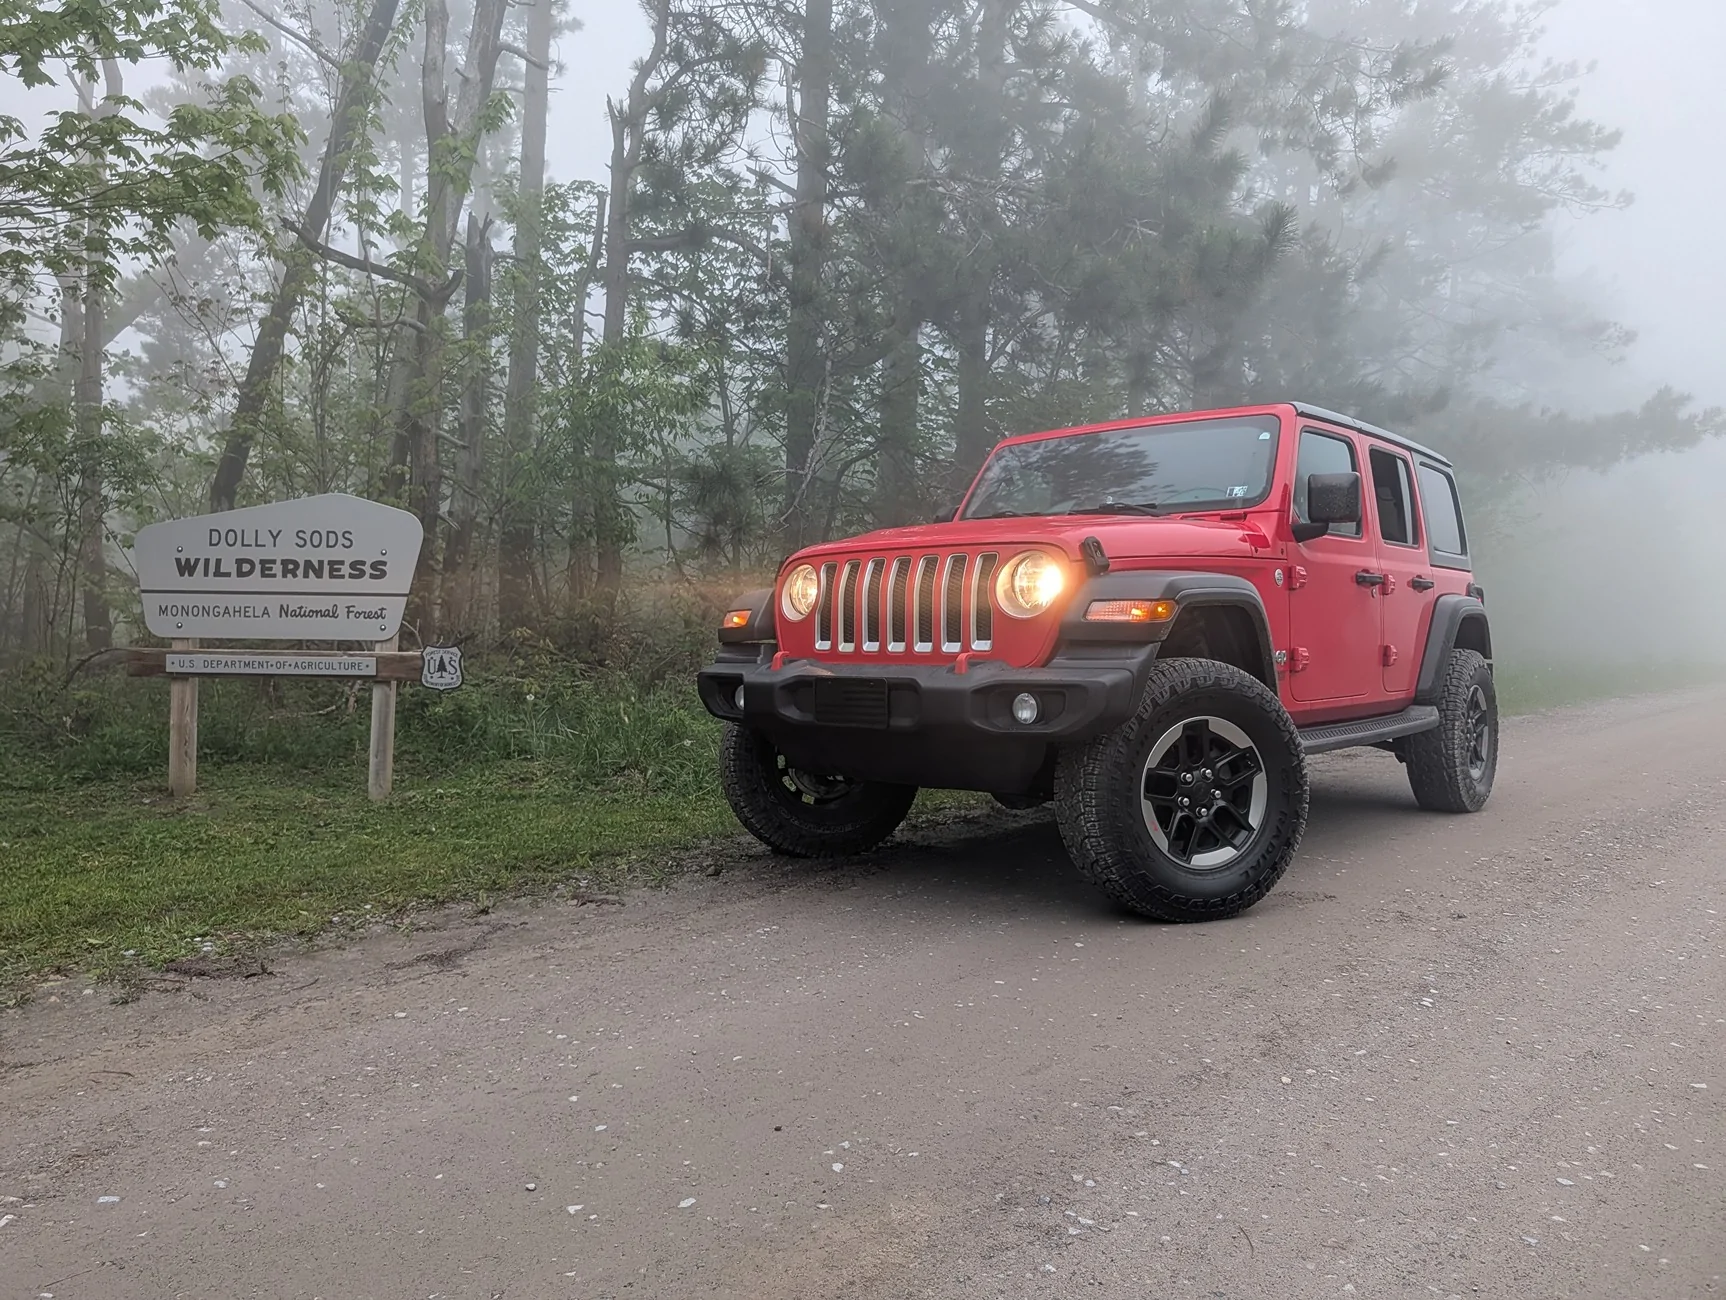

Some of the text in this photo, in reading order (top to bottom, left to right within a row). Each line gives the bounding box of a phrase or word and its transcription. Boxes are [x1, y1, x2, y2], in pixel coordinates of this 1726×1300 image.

[208, 528, 354, 549] DOLLY SODS
[174, 557, 388, 580] WILDERNESS
[158, 603, 387, 620] MONONGAHELA National Forest
